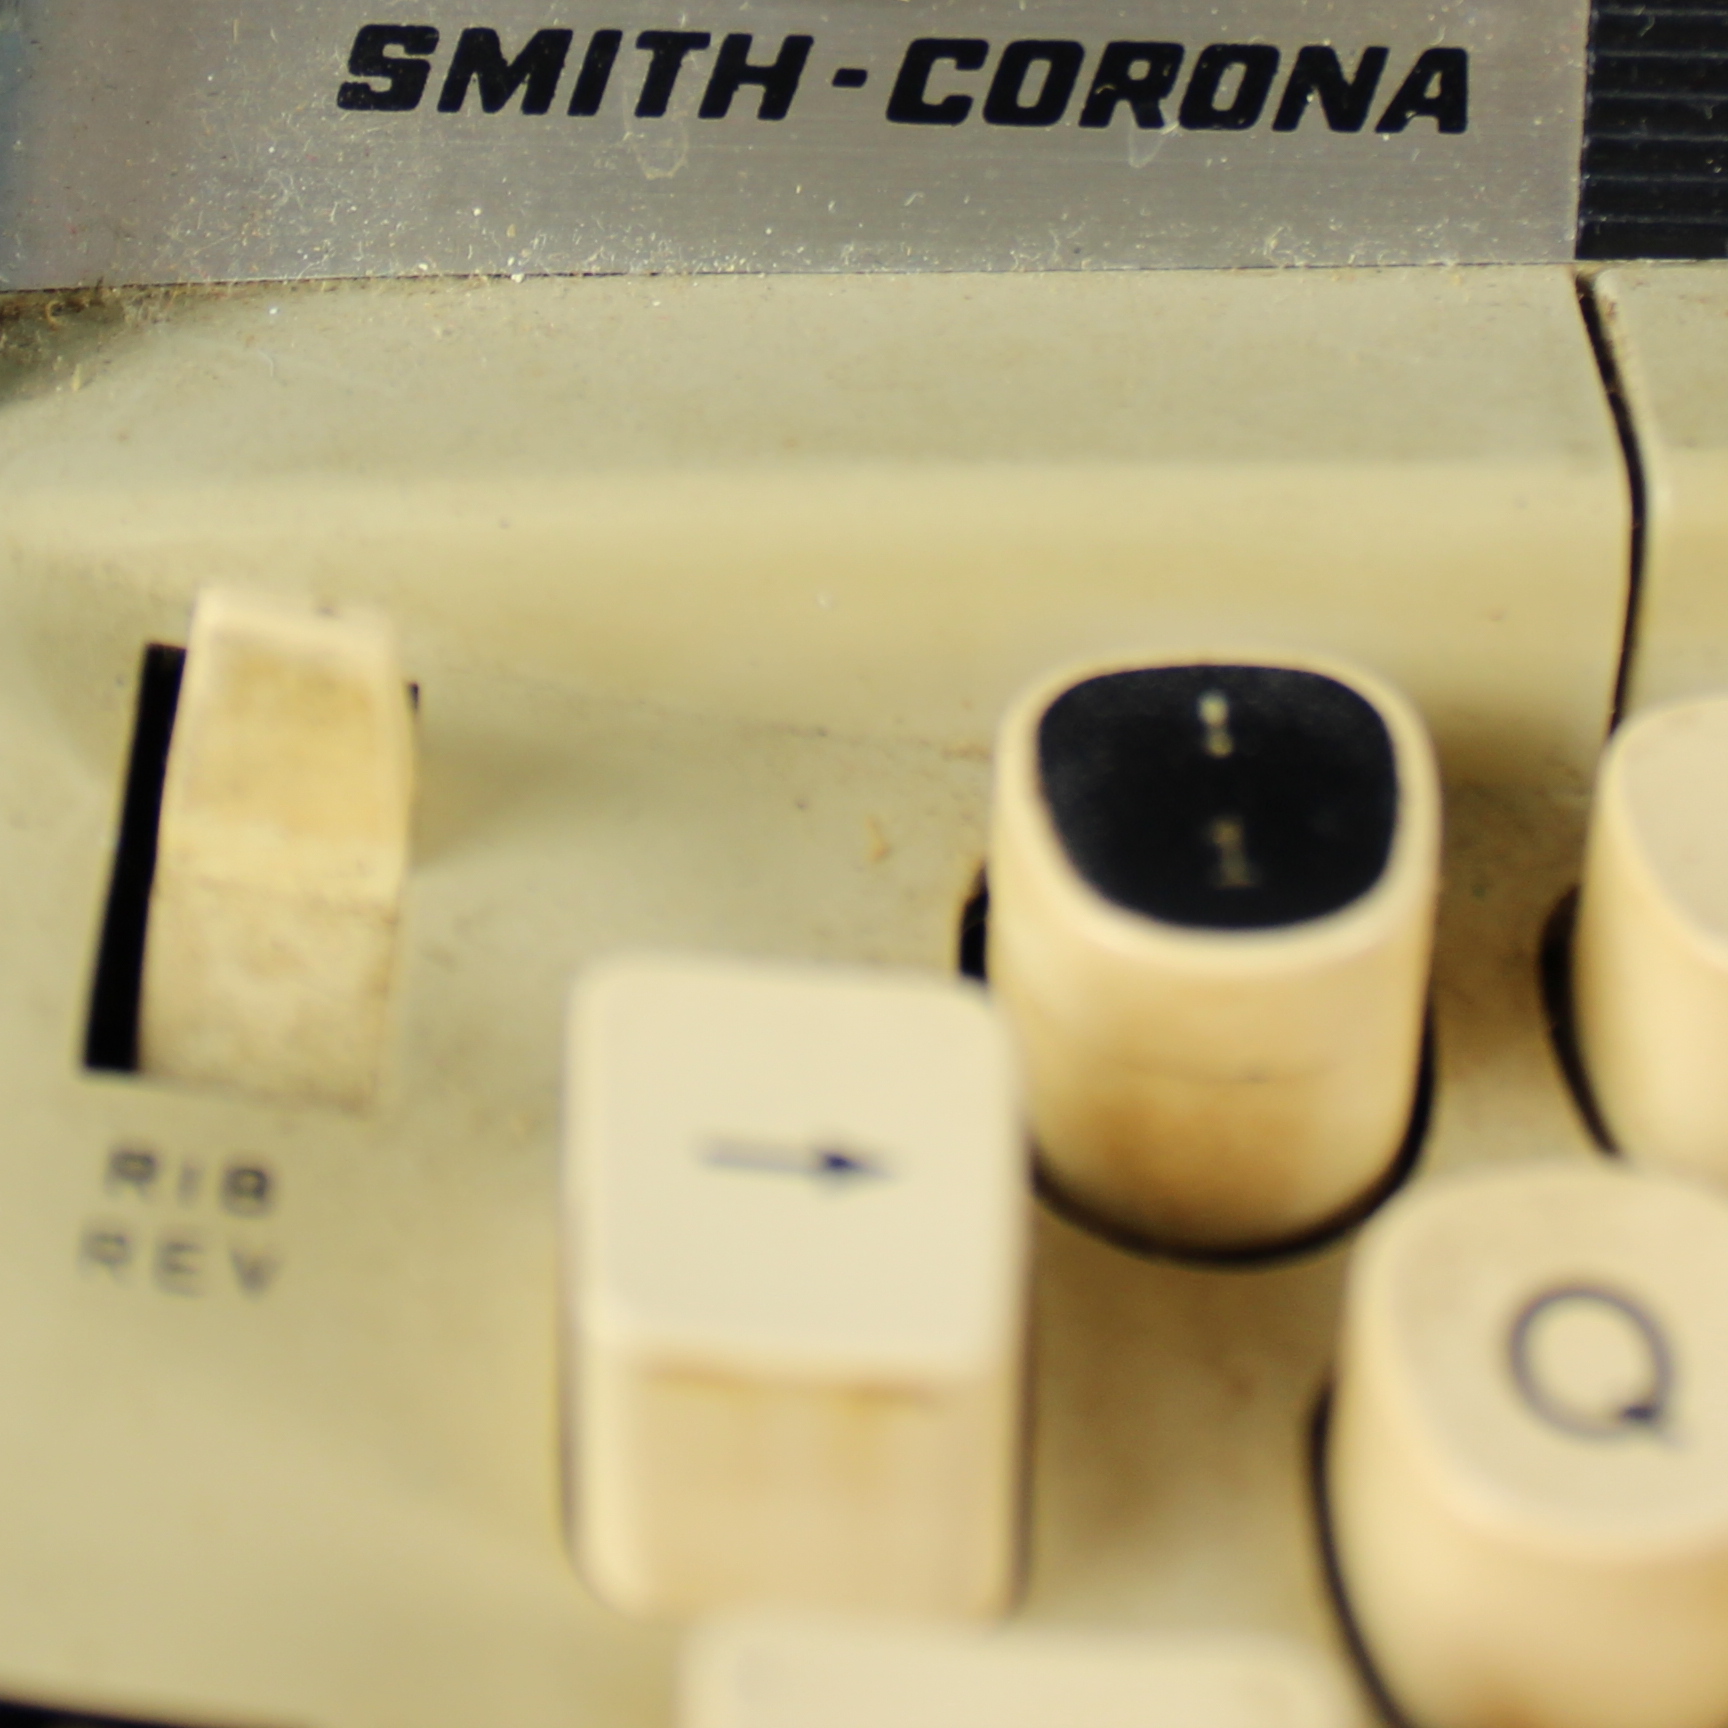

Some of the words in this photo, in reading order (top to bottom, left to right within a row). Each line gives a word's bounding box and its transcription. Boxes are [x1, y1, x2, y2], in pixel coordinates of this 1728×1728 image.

[103, 1145, 275, 1216] RIB
[80, 1228, 279, 1299] REV
[1503, 1279, 1688, 1452] Q
